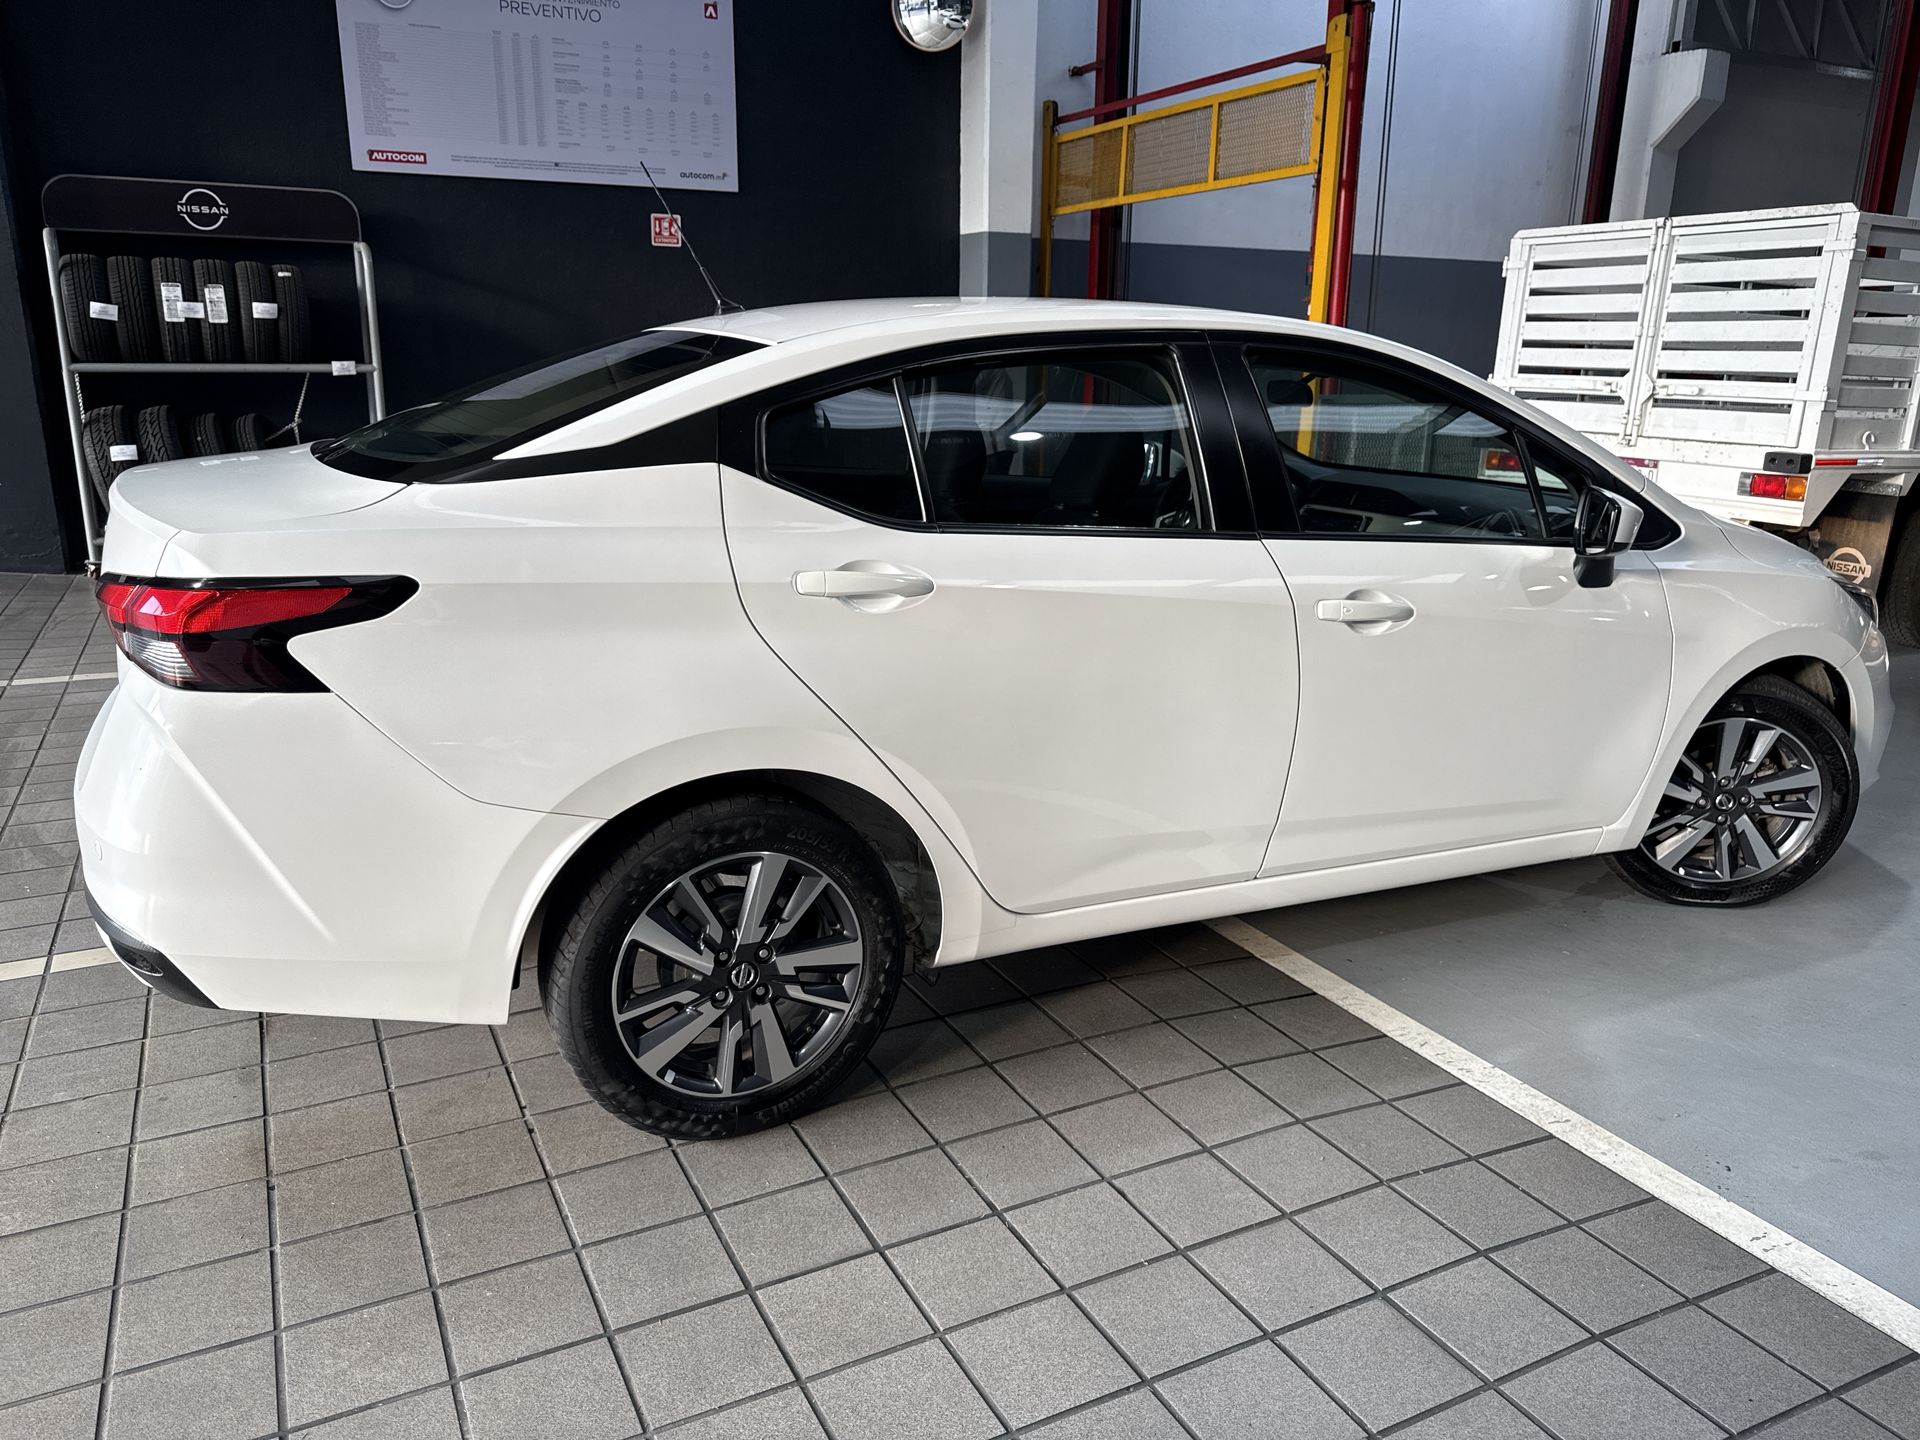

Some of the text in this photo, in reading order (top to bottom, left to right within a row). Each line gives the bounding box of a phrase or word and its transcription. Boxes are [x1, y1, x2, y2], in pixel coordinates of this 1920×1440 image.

[498, 0, 602, 23] PREVENTIVO
[371, 151, 425, 163] AUTOCOM
[177, 204, 229, 215] NISSAN
[1826, 561, 1866, 575] NISSAN
